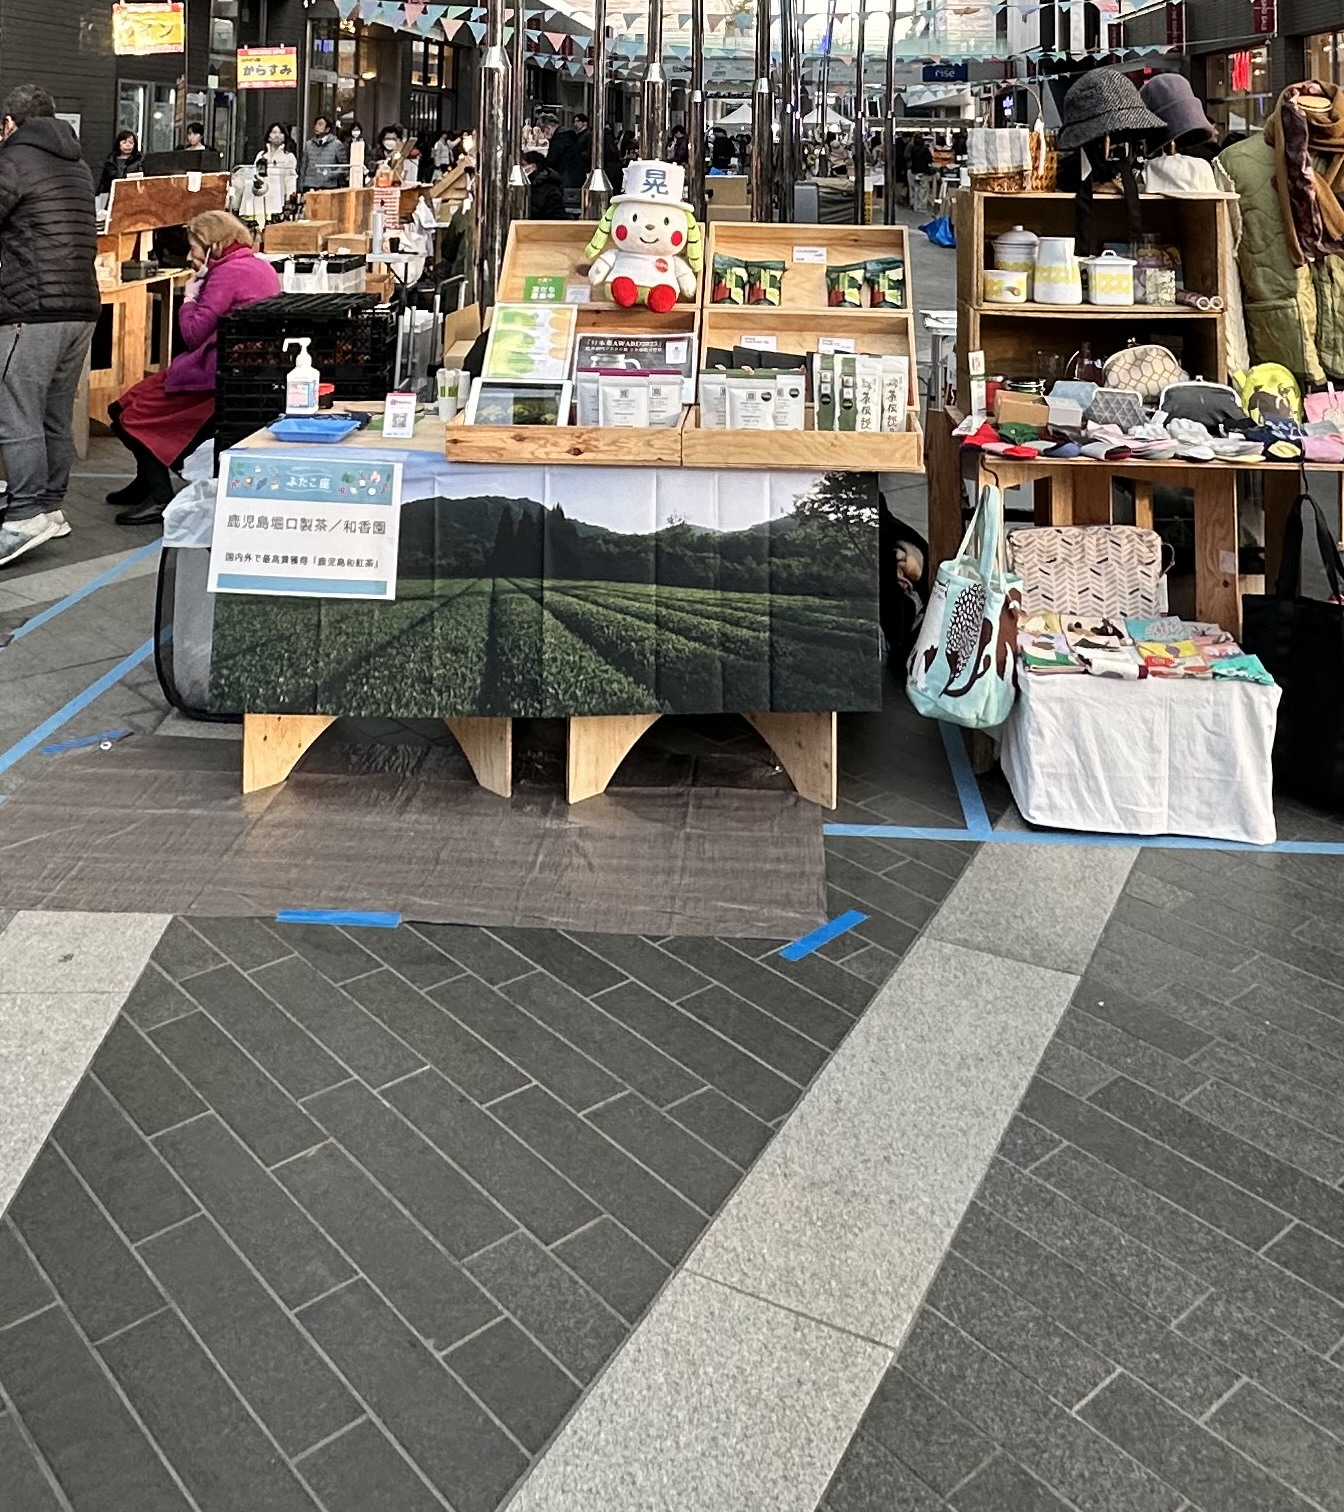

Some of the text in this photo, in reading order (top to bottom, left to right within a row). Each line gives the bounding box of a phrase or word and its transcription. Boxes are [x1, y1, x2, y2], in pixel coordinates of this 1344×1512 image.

[242, 63, 292, 76] からすみ
[935, 69, 956, 78] rise
[640, 169, 669, 195] 晃
[286, 476, 331, 489] ふたこ座
